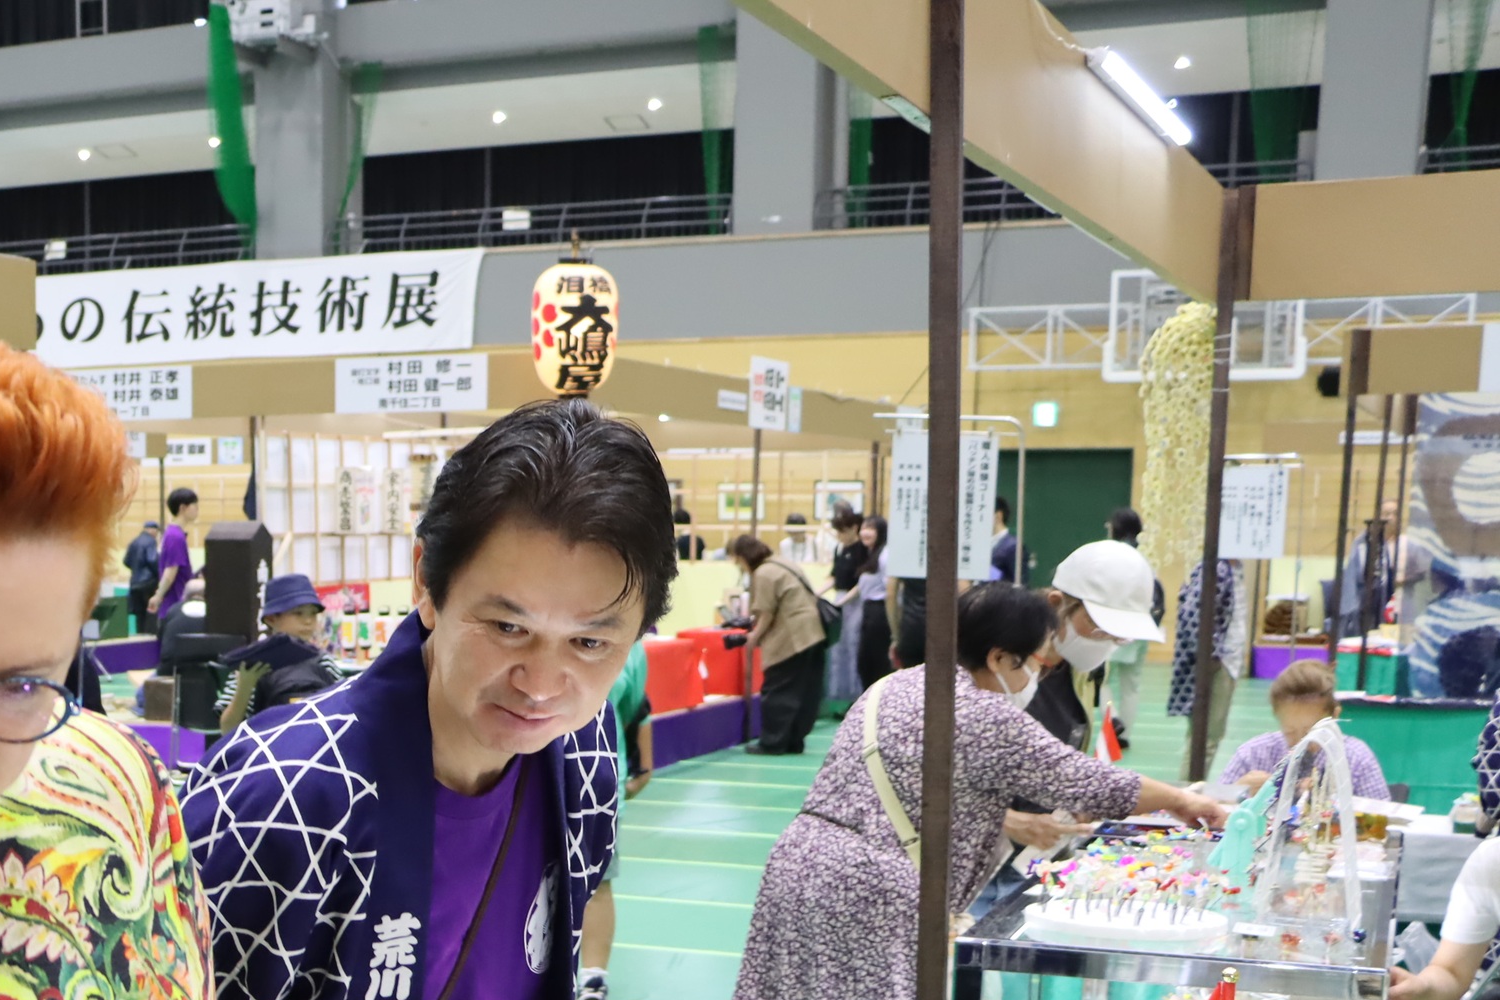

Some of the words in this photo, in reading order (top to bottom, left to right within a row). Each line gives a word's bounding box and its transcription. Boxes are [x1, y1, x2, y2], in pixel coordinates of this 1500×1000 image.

[36, 270, 441, 343] の伝統技術展
